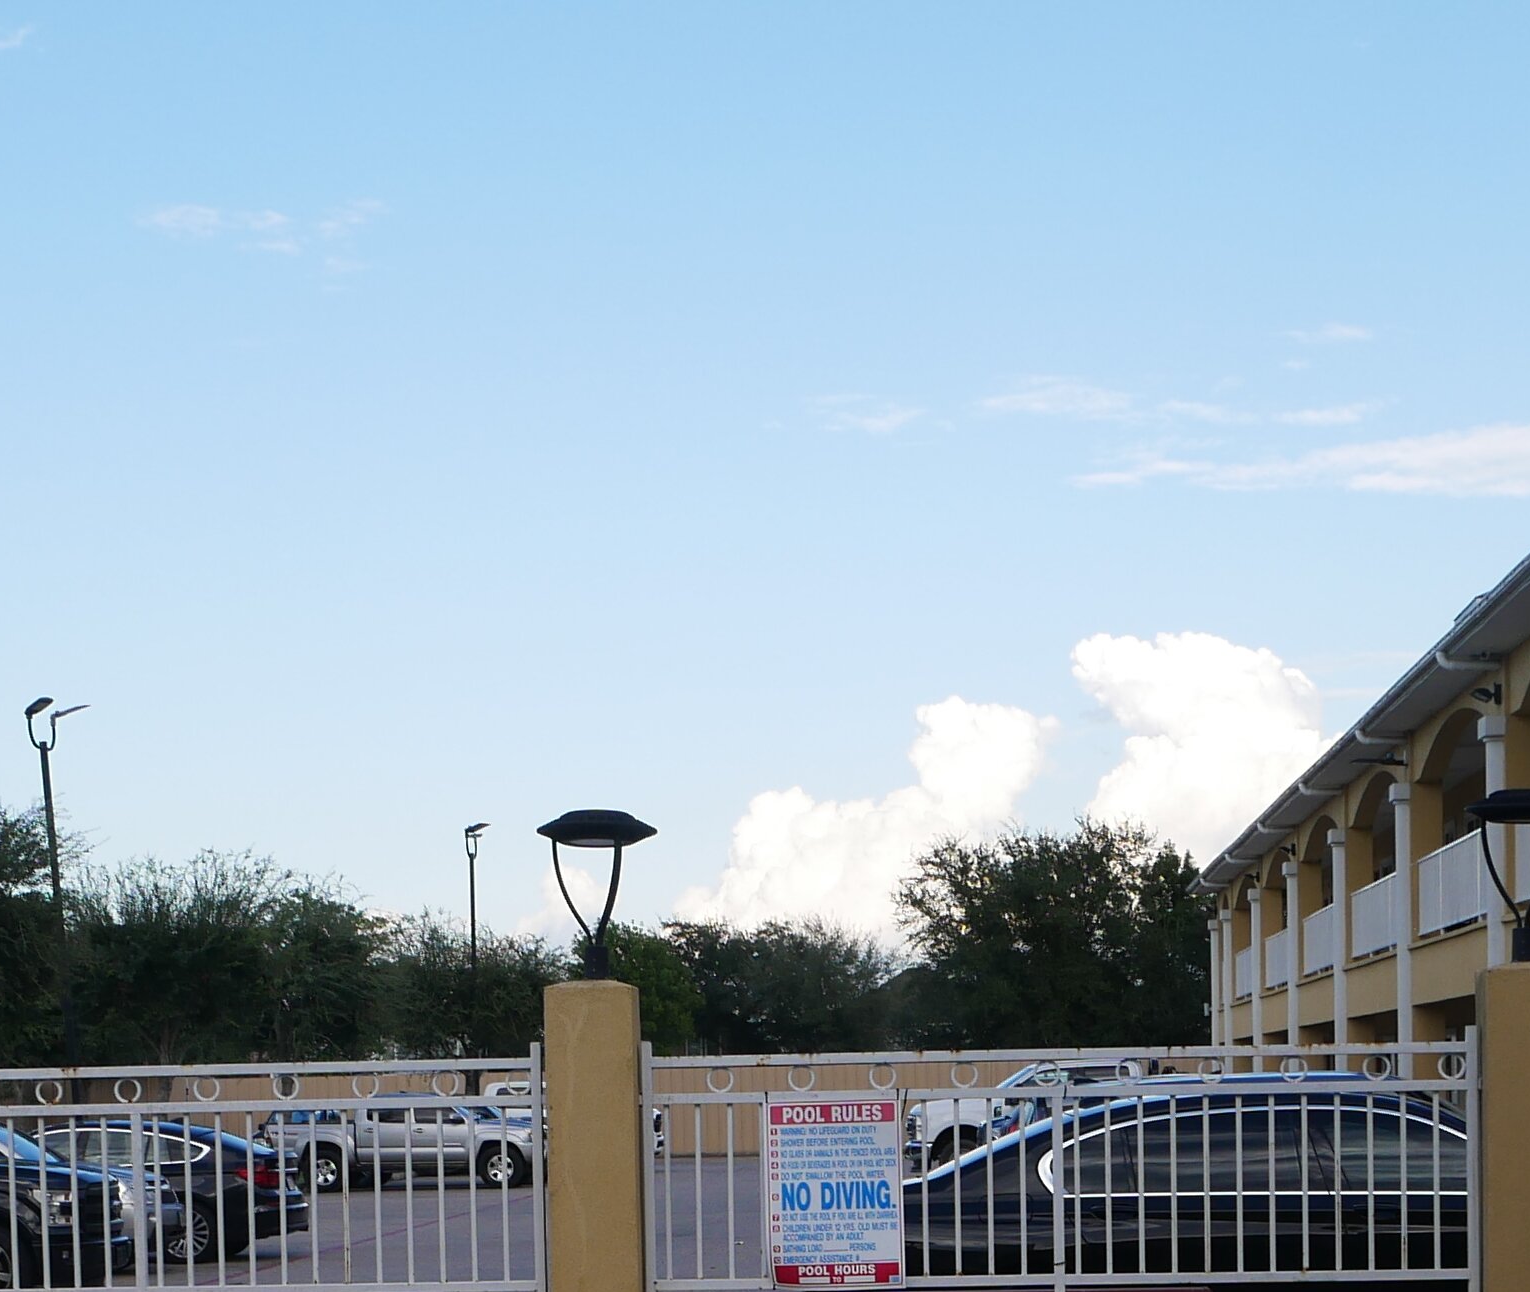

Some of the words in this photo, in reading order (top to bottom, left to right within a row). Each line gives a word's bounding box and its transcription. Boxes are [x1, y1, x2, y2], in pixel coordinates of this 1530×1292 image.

[782, 1107, 825, 1124] POOL
[831, 1105, 883, 1122] RULES
[809, 1127, 817, 1135] NO
[818, 1126, 850, 1135] LIFEGUARD
[851, 1126, 860, 1134] ON
[780, 1138, 804, 1147] SHOWER
[806, 1138, 829, 1146] BEFORE
[830, 1137, 858, 1146] ENTERING
[870, 1148, 881, 1156] POOL
[781, 1172, 789, 1181] DO
[791, 1172, 803, 1180] NOT
[805, 1171, 833, 1180] SWALLOW
[835, 1171, 846, 1179] THE
[848, 1171, 864, 1179] POOL
[781, 1182, 811, 1211] NO
[821, 1180, 896, 1210] DIVING.
[782, 1224, 811, 1232] CHILDREN
[813, 1224, 832, 1232] UNDER
[835, 1223, 841, 1231] 12
[857, 1223, 870, 1231] OLD
[872, 1222, 888, 1230] MUST
[783, 1233, 825, 1241] ACCOMPANIED
[826, 1233, 834, 1241] BY
[836, 1232, 844, 1240] AN
[783, 1245, 806, 1253] BATHING
[808, 1244, 822, 1252] LOAD
[783, 1256, 817, 1264] EMERGENCY
[820, 1255, 853, 1263] ASSISTANCE
[798, 1266, 830, 1276] POOL
[834, 1264, 876, 1275] HOURS
